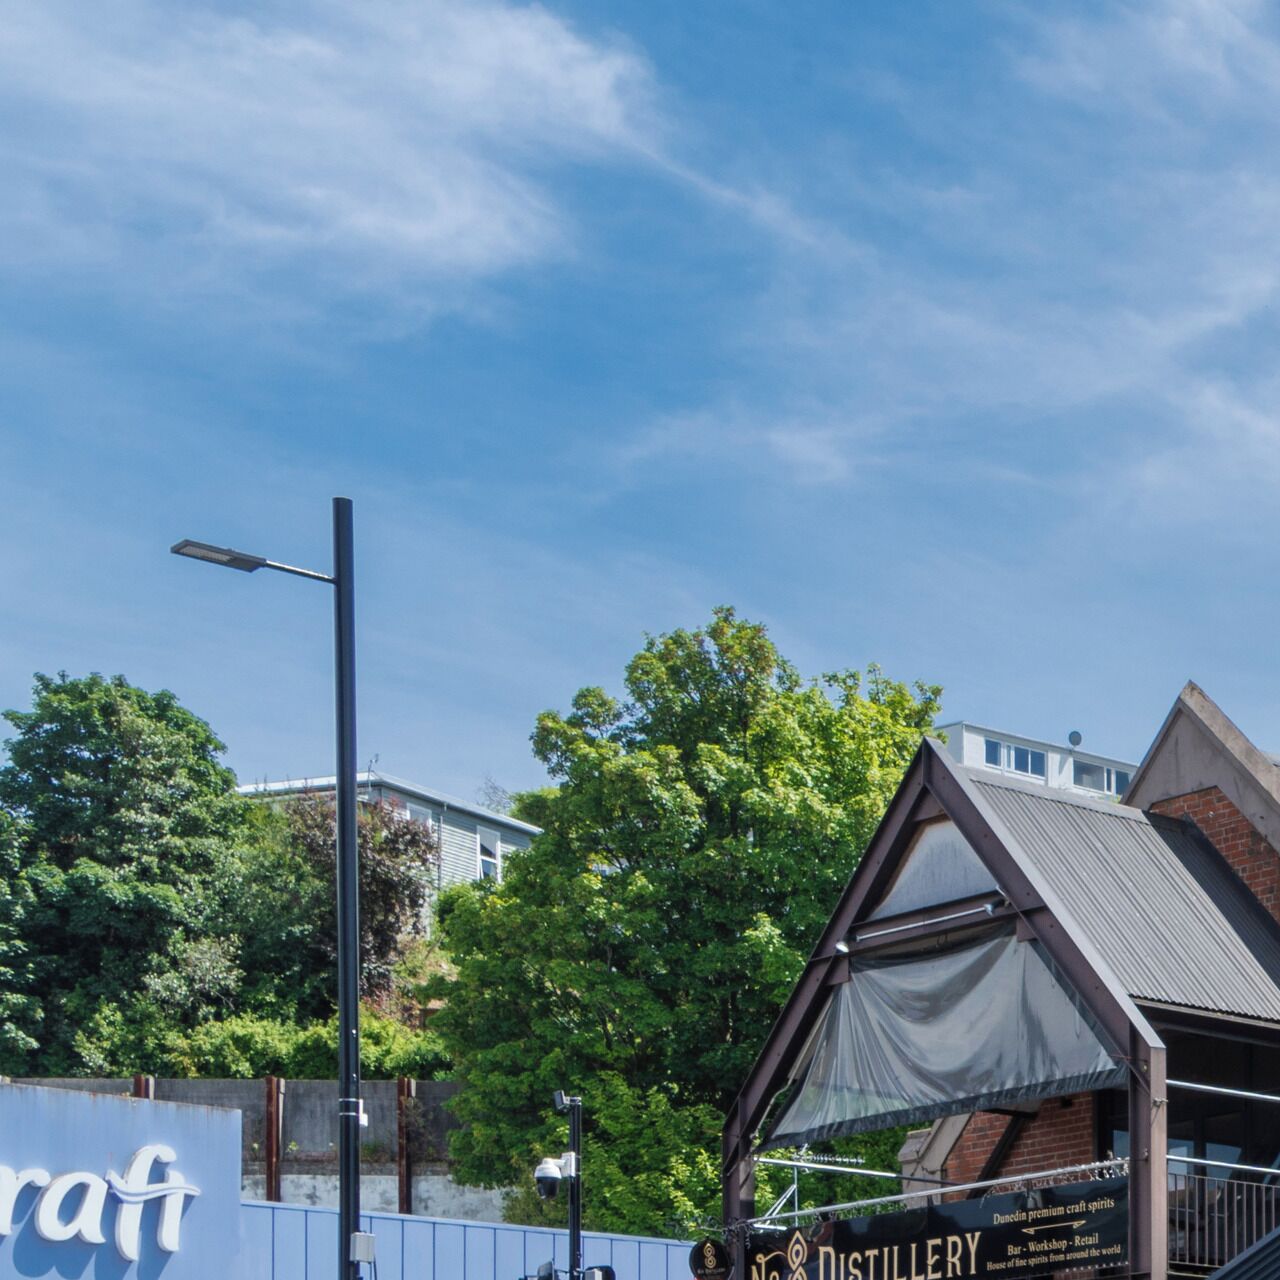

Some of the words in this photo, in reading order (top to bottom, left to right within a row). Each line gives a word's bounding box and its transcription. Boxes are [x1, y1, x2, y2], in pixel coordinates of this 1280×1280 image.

[993, 1208, 1027, 1225] Dunedin
[1028, 1205, 1065, 1222] premium
[1066, 1200, 1087, 1214] craft
[1087, 1197, 1115, 1214] spirits
[986, 1260, 1007, 1271] House
[1007, 1259, 1015, 1268] of
[1015, 1257, 1027, 1267] fine
[1028, 1254, 1048, 1267] spirits
[1049, 1252, 1065, 1262] from
[1066, 1249, 1089, 1260] around
[1089, 1246, 1100, 1257] the
[1101, 1244, 1121, 1255] world
[1007, 1244, 1022, 1256] Bar
[1028, 1239, 1068, 1253] Workshop
[1074, 1232, 1099, 1247] Retail
